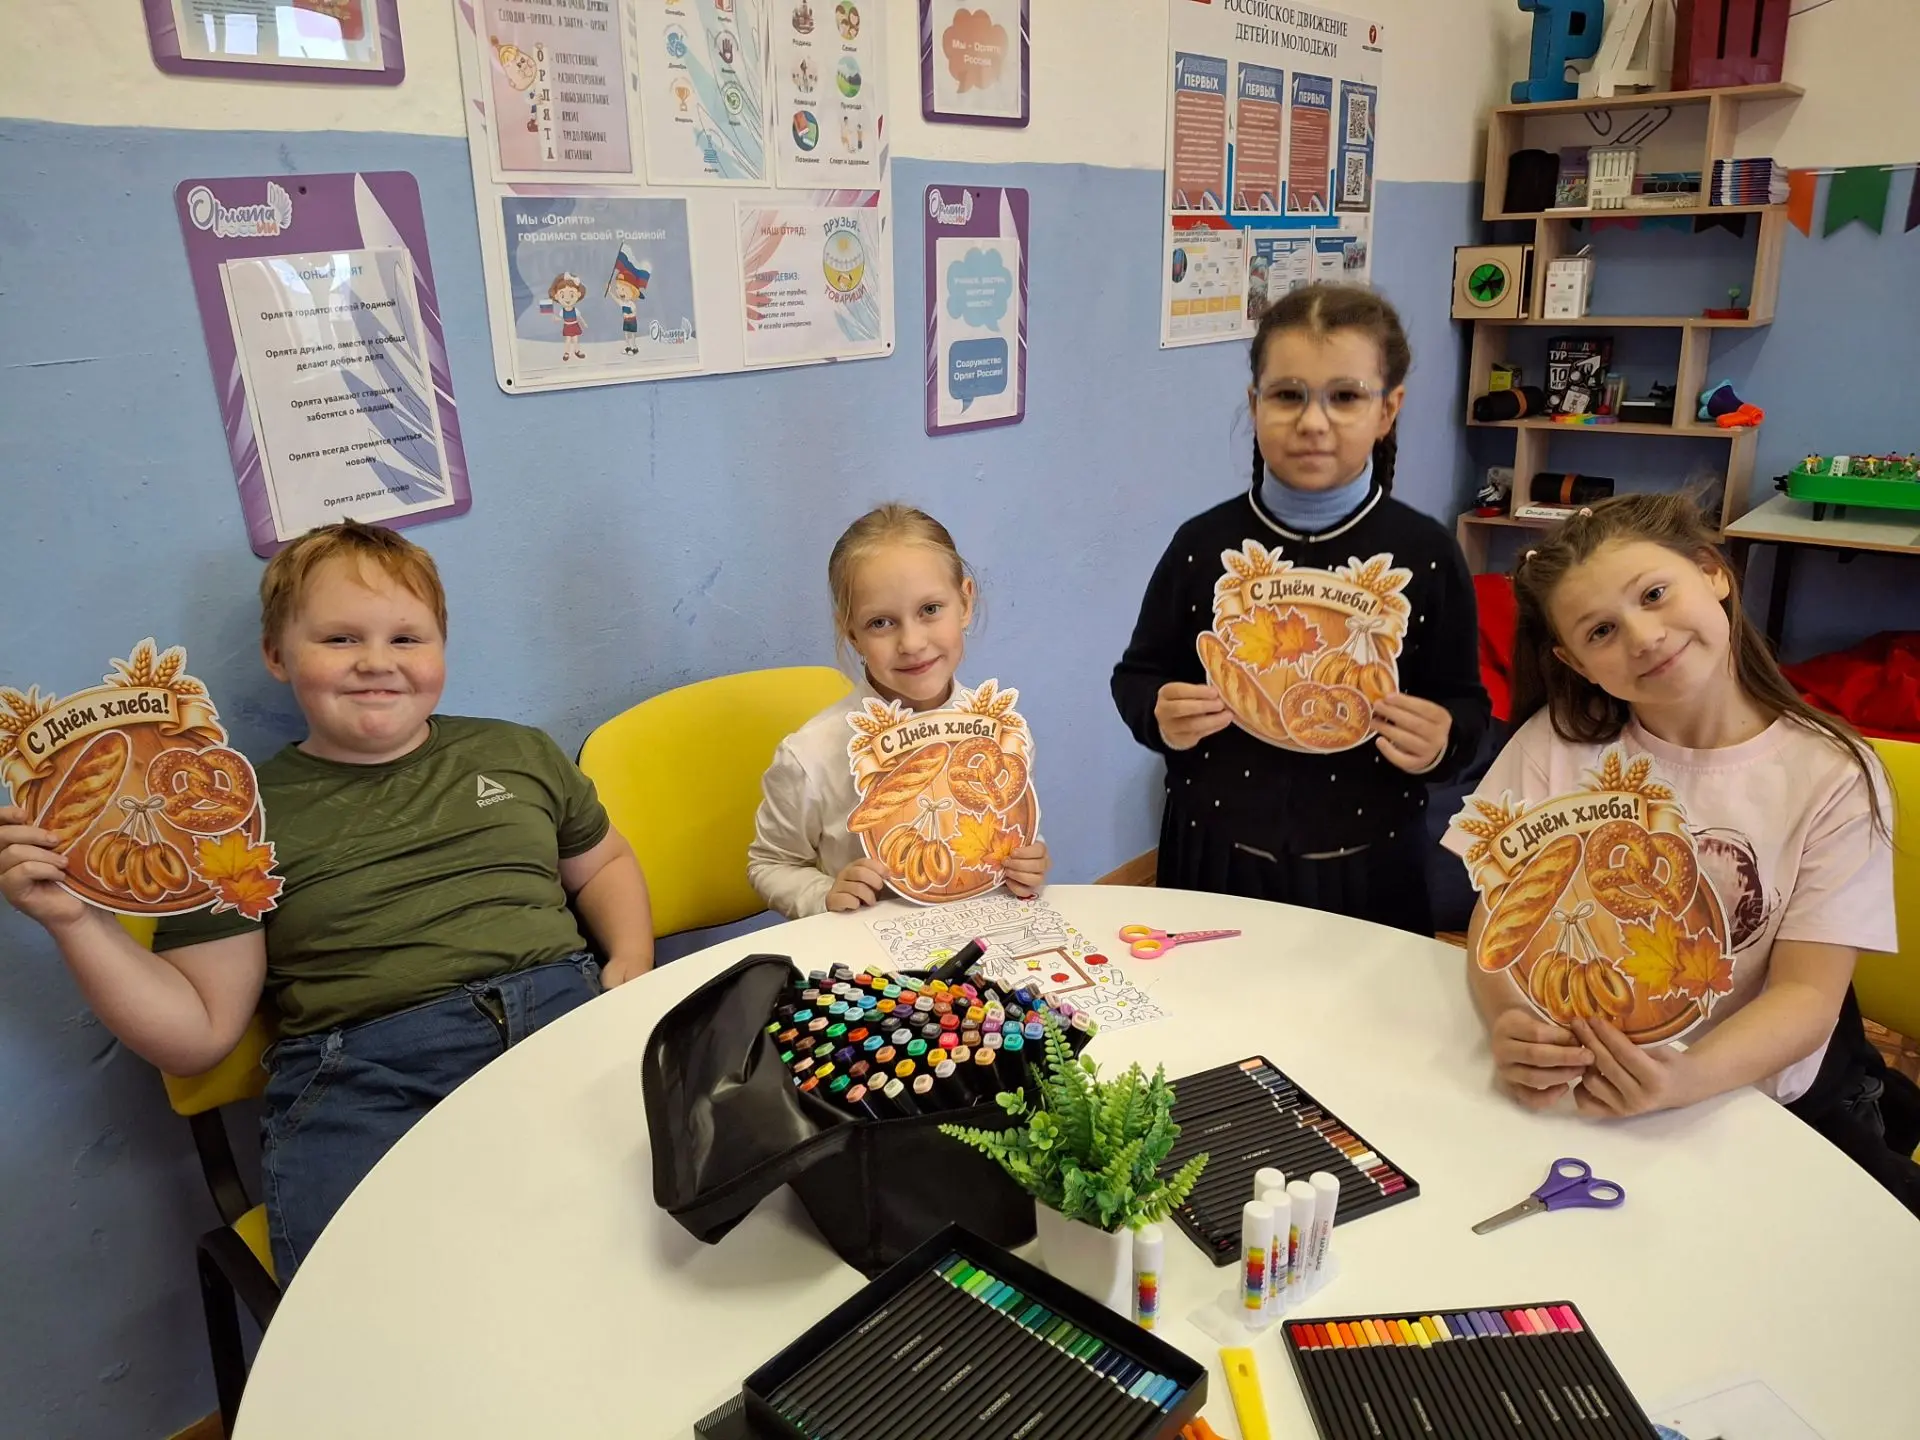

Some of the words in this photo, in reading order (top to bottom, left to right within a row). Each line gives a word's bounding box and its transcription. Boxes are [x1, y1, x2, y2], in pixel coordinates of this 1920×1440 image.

[1224, 0, 1296, 25] РОССИЙСКОЕ
[1296, 11, 1348, 37] ДВИЖЕНИЕ
[1236, 22, 1268, 44] ДЕТЕЙ
[1272, 30, 1278, 46] И
[1281, 32, 1337, 58] МОЛОДЕЖИ
[1184, 74, 1218, 90] ПЕРВЫХ
[1246, 82, 1276, 98] ПЕРВЫХ
[1298, 90, 1325, 105] ПЕРВЫХ
[516, 214, 538, 226] Мы
[542, 214, 595, 227] «Орлята»
[518, 230, 578, 244] гордимся
[580, 228, 613, 240] своей
[616, 228, 666, 241] Родиной!
[760, 226, 778, 236] НАШ
[260, 311, 293, 322] Орлята
[360, 298, 396, 310] Родиной
[266, 348, 298, 359] Орлята
[300, 344, 336, 355] дружно,
[338, 338, 366, 350] вместе
[375, 334, 406, 345] сообща
[1550, 350, 1568, 360] ТУР
[296, 360, 328, 372] делают
[330, 355, 362, 366] добрые
[364, 353, 384, 362] дела
[954, 372, 975, 381] Орлят
[1552, 368, 1568, 382] 10
[290, 398, 322, 409] Орлята
[324, 392, 361, 406] уважают
[361, 388, 395, 398] старших
[306, 409, 348, 422] заботятся
[356, 402, 394, 414] младших
[288, 450, 320, 462] Орлята
[322, 444, 349, 456] всегда
[351, 438, 391, 451] стремятся
[392, 433, 422, 444] учиться
[346, 456, 376, 468] новому
[324, 494, 354, 507] Орлята
[356, 489, 386, 502] держат
[387, 484, 410, 494] слово
[1250, 582, 1263, 600] С
[1268, 579, 1314, 600] Днём
[1320, 585, 1378, 617] хлеба!
[26, 733, 46, 754] С
[44, 708, 98, 746] Днём
[100, 692, 170, 718] хлеба!
[880, 735, 894, 754] С
[898, 722, 940, 748] Днём
[944, 722, 997, 738] хлеба!
[476, 792, 514, 808] Reebok
[1500, 836, 1518, 859] С
[1518, 810, 1570, 852] Днём
[1572, 796, 1639, 823] хлеба!
